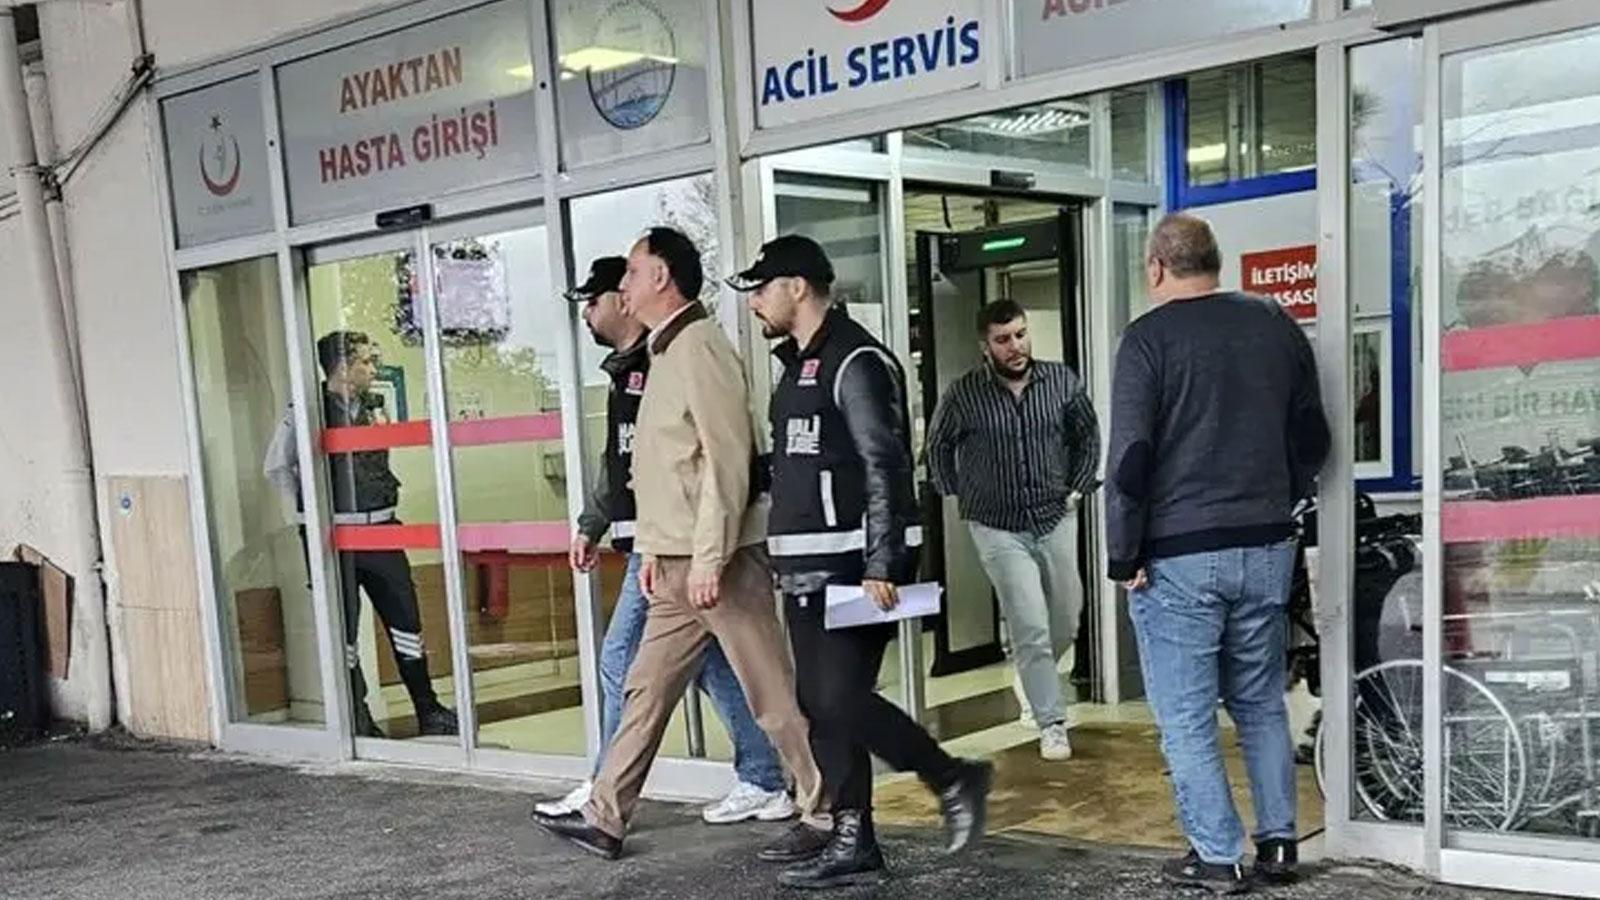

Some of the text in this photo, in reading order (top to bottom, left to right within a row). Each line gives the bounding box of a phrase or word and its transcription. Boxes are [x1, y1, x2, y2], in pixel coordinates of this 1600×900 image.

[339, 47, 463, 114] AYAKTAN
[761, 15, 980, 106] ACİL SERVİS
[319, 100, 499, 183] HASTA GİRİŞİ
